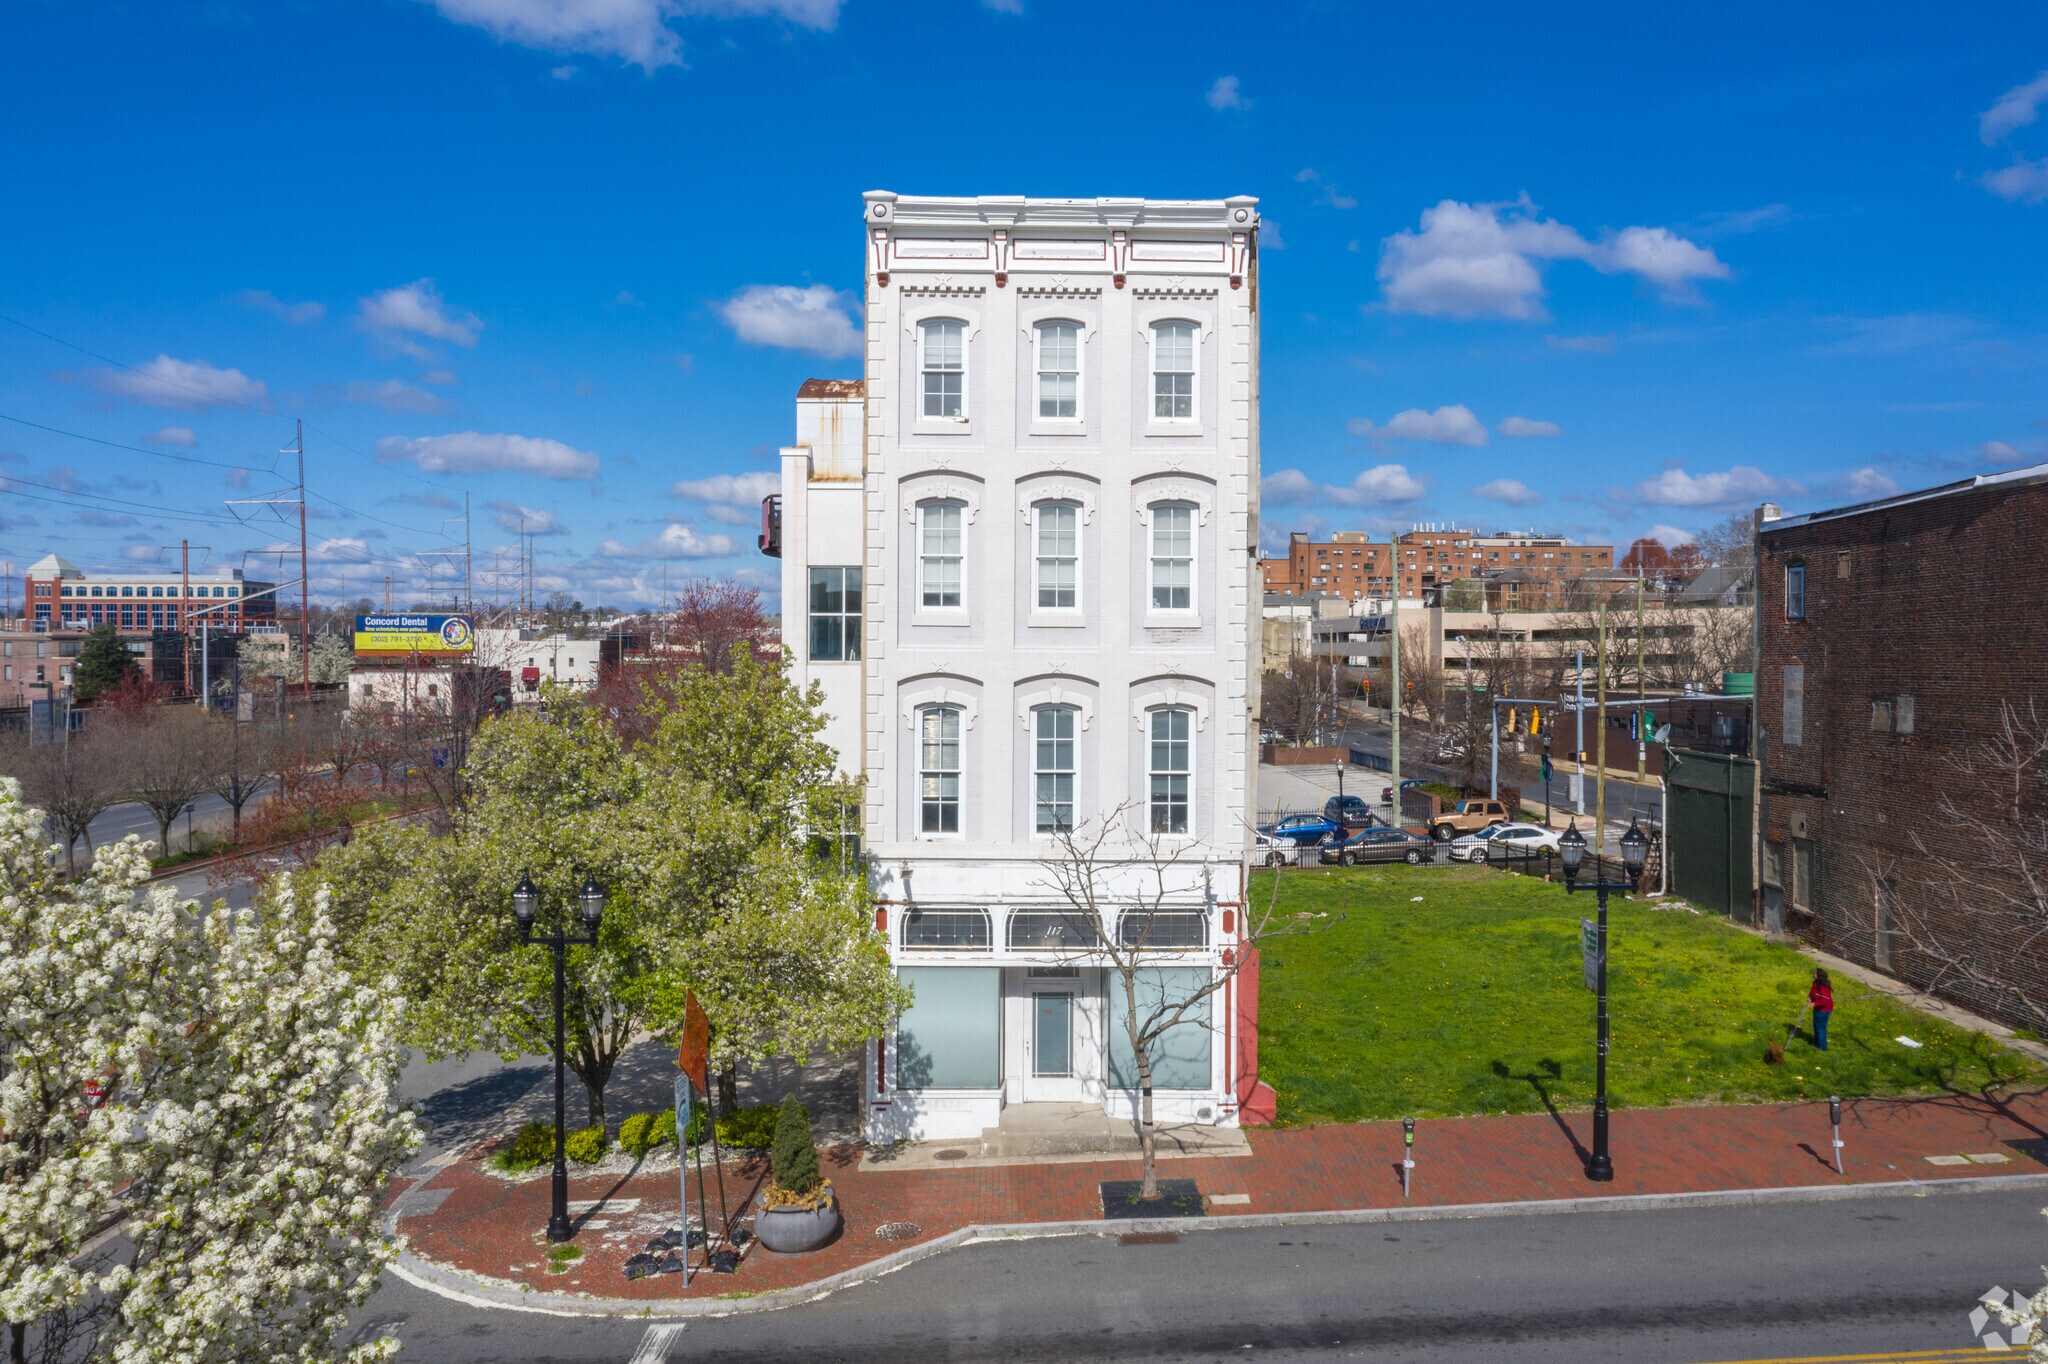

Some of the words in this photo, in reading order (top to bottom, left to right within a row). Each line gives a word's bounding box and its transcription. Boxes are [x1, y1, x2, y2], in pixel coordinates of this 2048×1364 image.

[365, 617, 400, 625] Concord
[401, 617, 428, 625] Dental
[1047, 925, 1063, 935] 117
